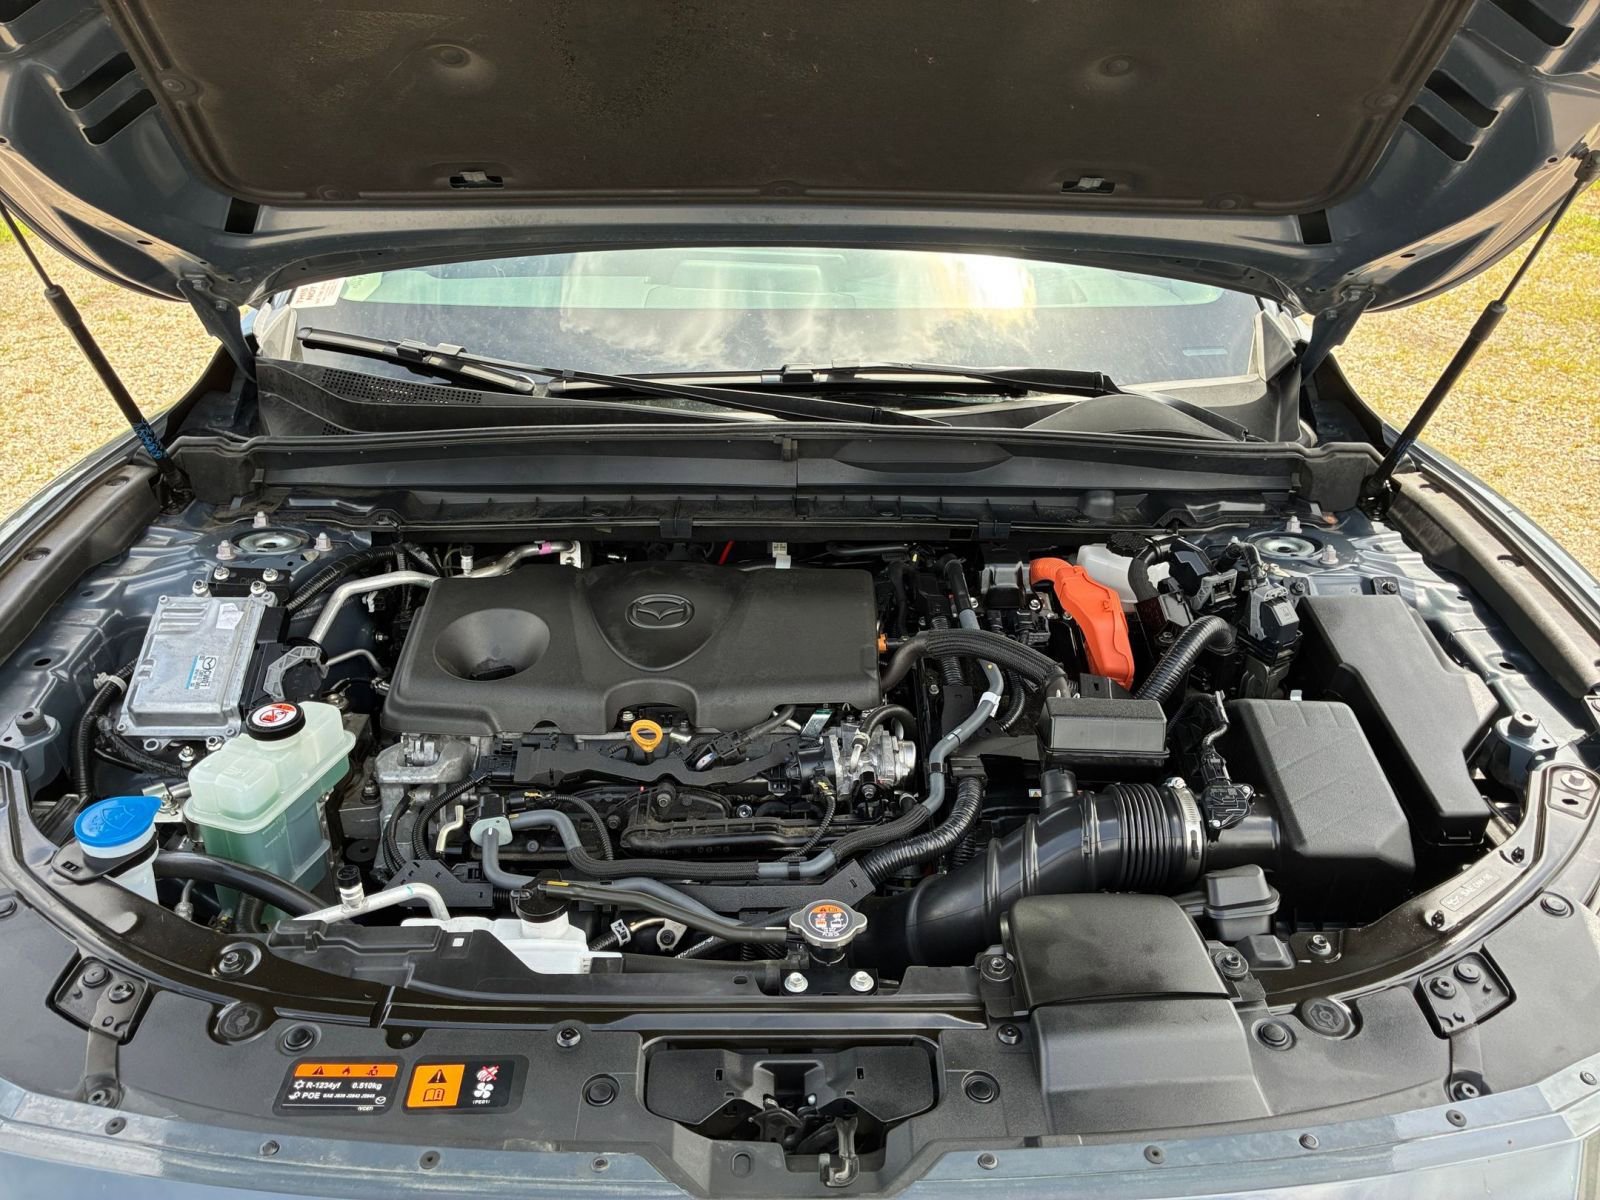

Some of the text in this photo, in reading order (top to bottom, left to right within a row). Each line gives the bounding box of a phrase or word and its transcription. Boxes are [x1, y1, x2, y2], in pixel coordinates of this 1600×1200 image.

[306, 1081, 382, 1090] R-1234yf 0.510kg
[302, 1091, 321, 1099] POE
